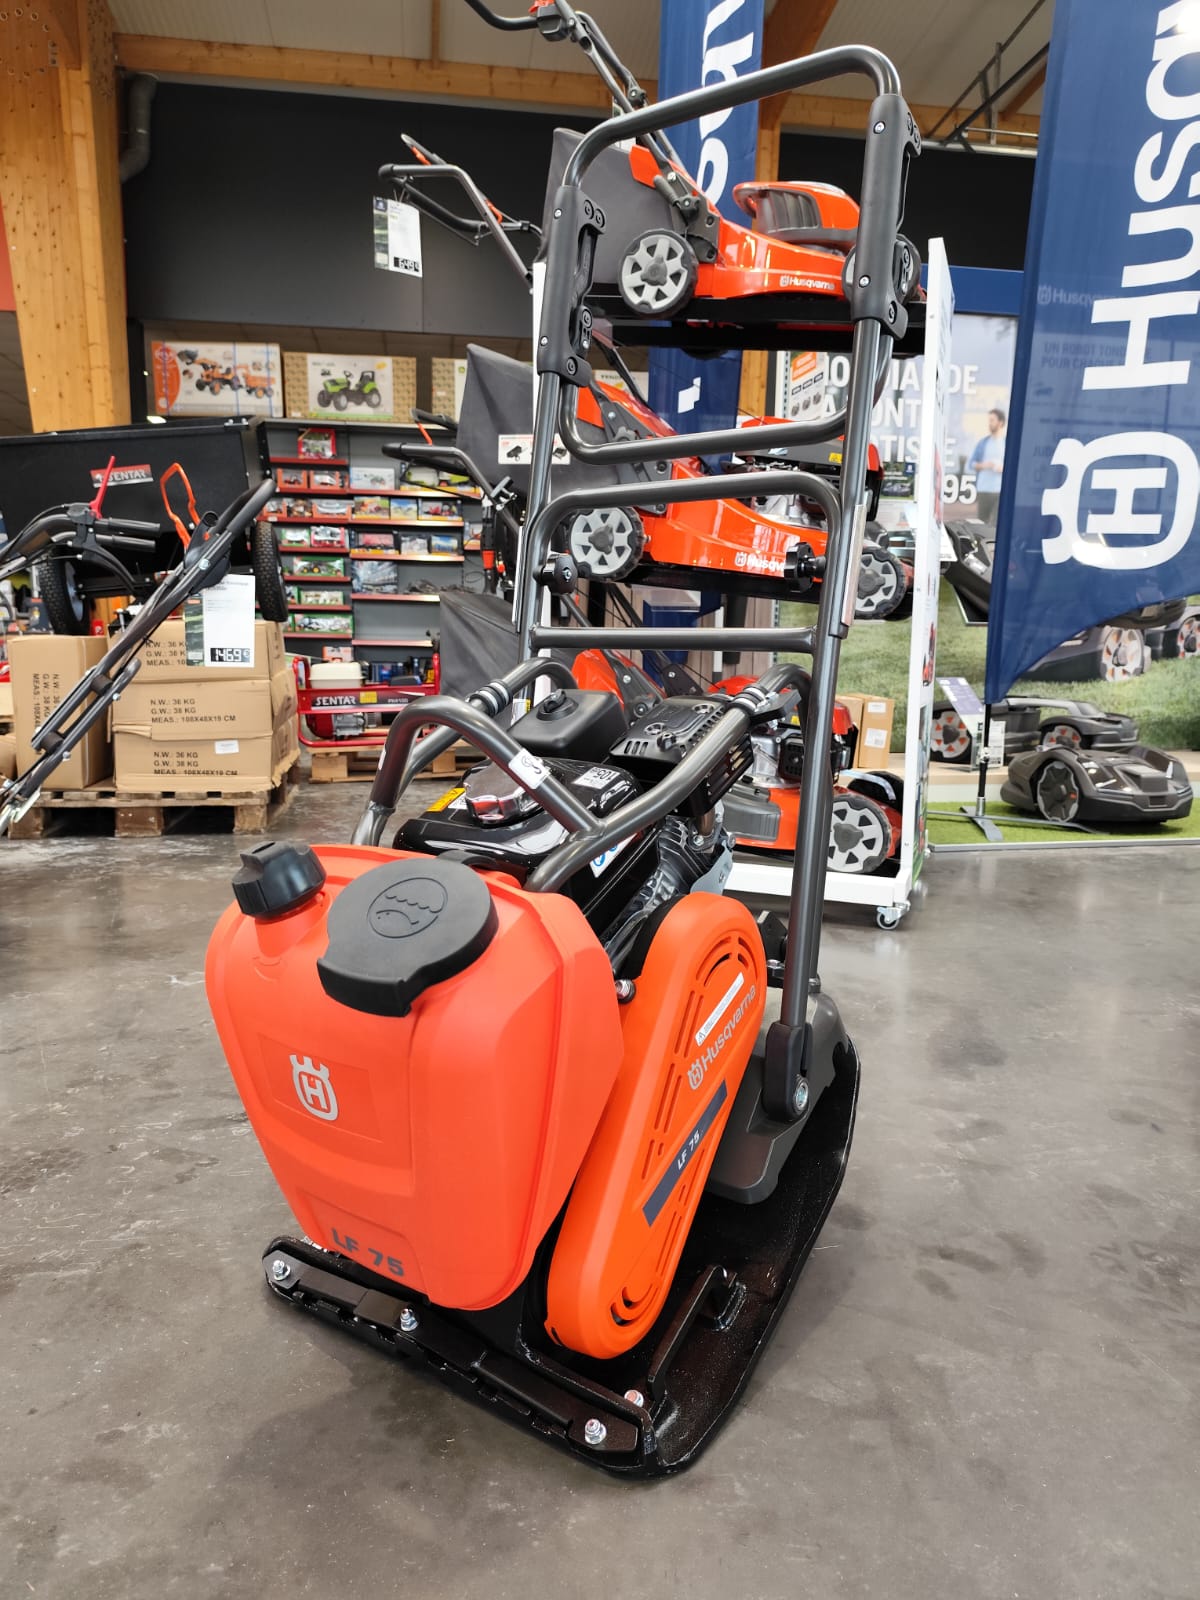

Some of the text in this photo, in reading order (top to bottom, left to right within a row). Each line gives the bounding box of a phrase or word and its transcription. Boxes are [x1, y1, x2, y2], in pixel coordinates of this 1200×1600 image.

[790, 276, 835, 291] Husqvarna
[315, 695, 356, 706] SENTAR
[223, 714, 236, 722] CM
[186, 751, 199, 759] KG
[701, 985, 756, 1071] Husqvarna
[677, 1129, 701, 1170] LF 75
[331, 1226, 405, 1278] LF 75
